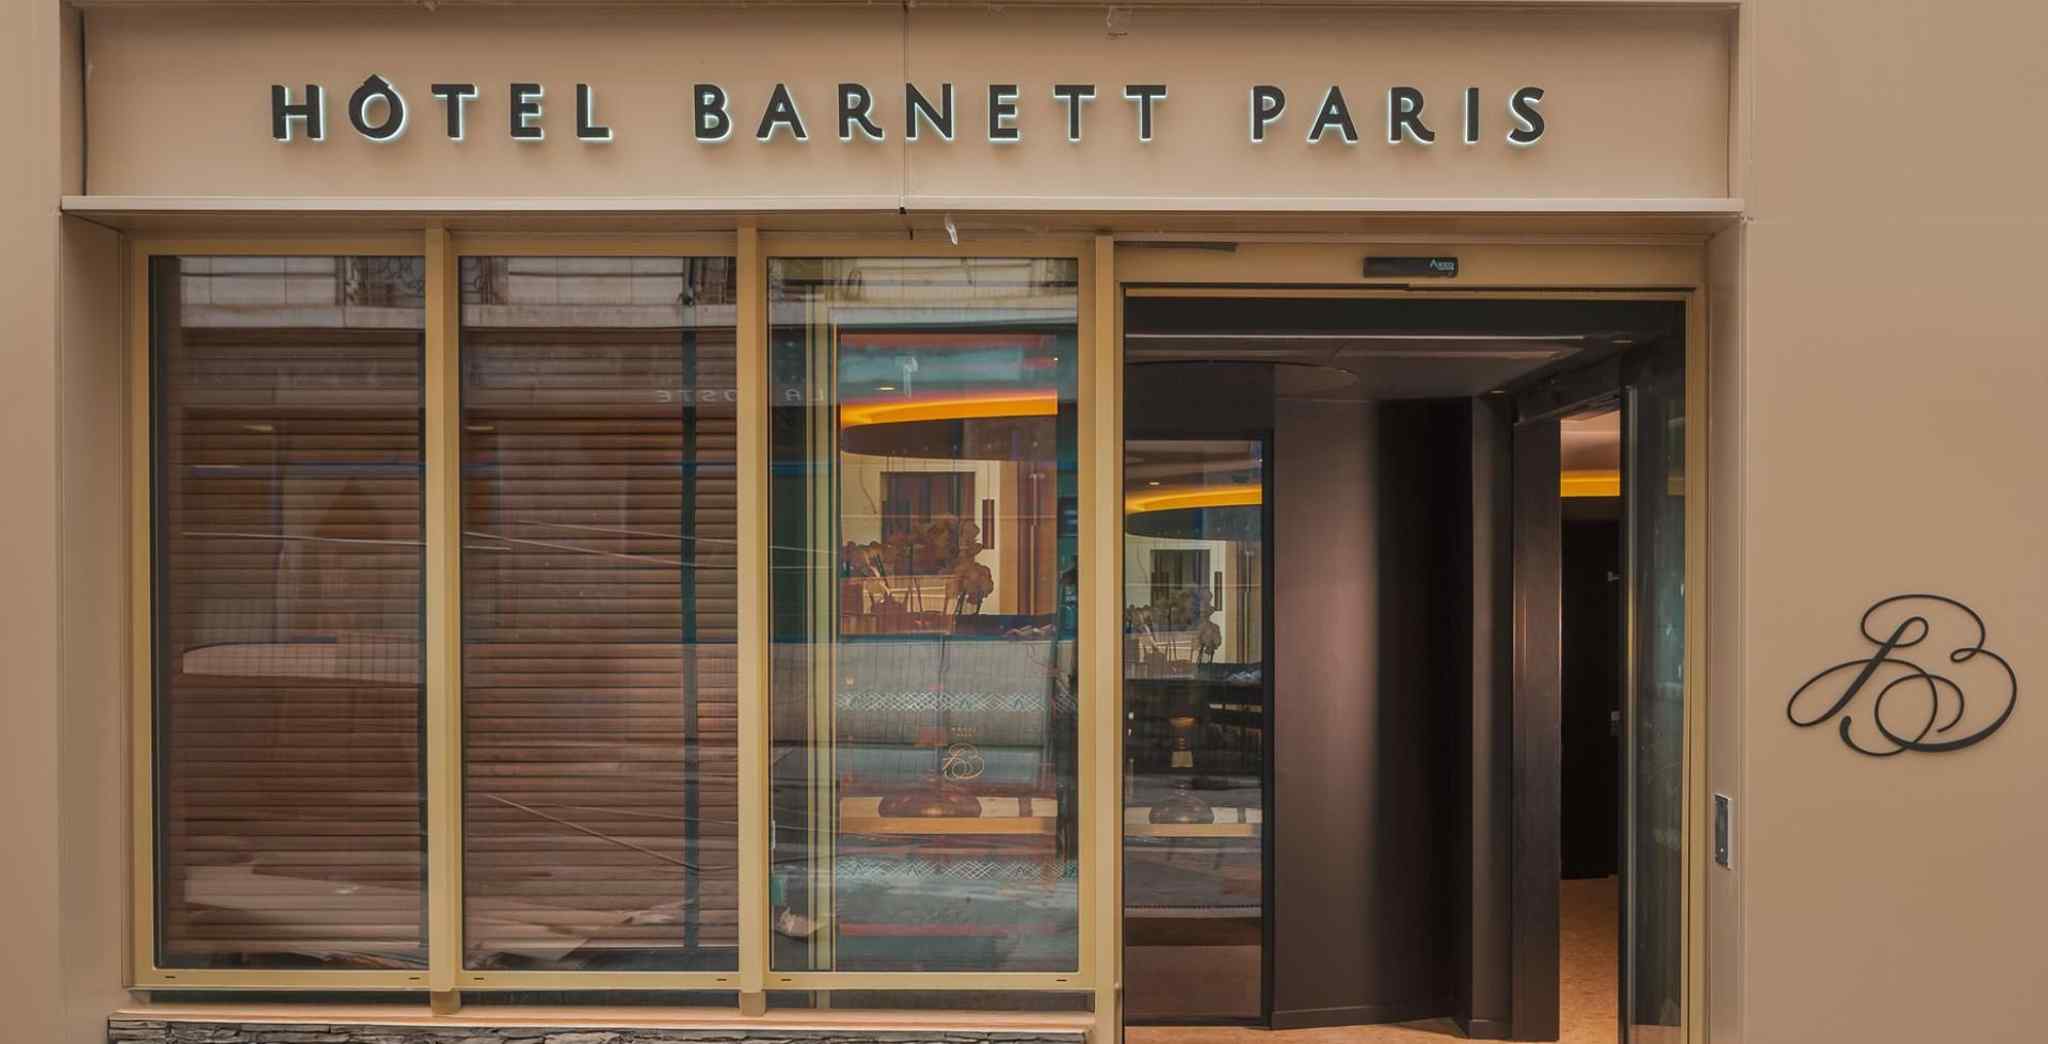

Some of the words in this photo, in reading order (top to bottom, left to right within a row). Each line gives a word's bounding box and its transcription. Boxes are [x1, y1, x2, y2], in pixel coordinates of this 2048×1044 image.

[270, 74, 614, 142] HÔTEL
[693, 83, 1170, 143] BARNETT
[1250, 85, 1548, 145] PARIS
